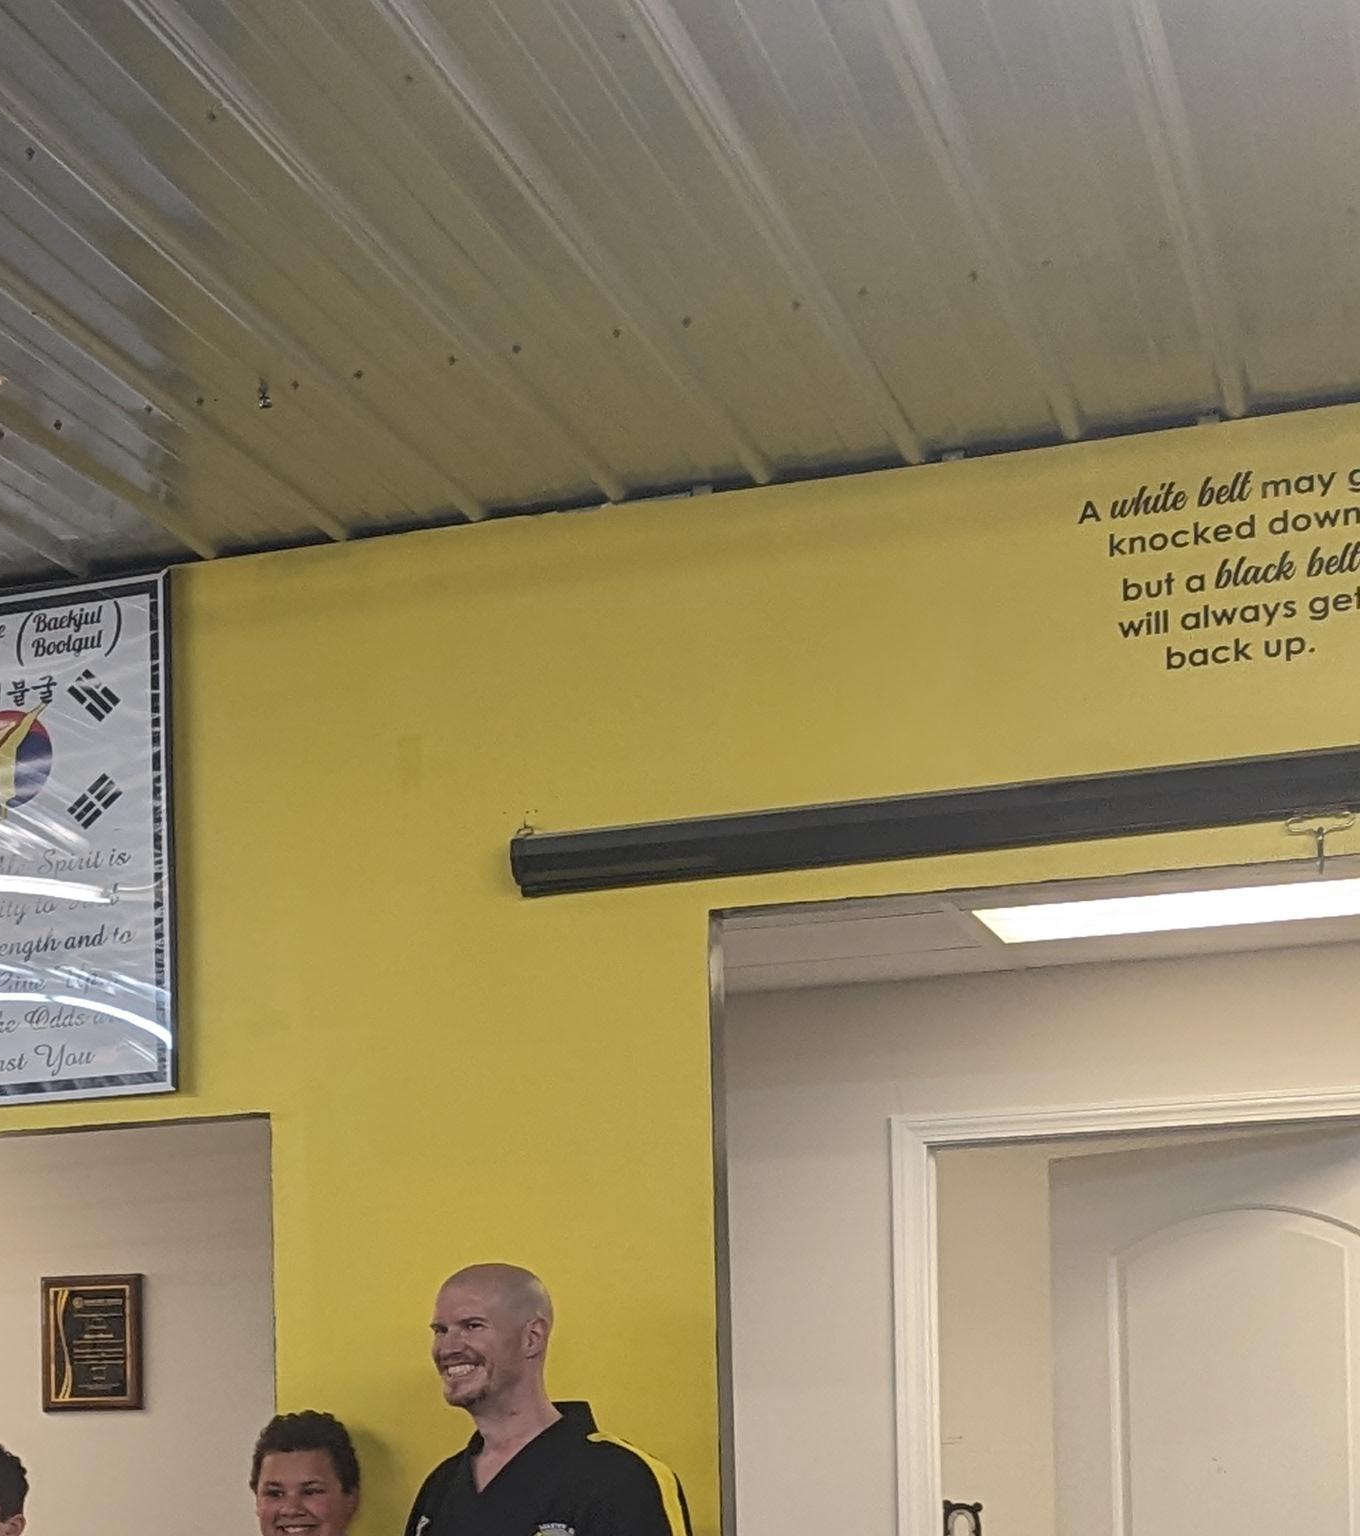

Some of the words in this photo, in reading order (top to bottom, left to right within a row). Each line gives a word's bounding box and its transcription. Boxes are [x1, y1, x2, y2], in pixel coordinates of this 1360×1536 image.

[1078, 501, 1101, 524] A
[1111, 481, 1188, 519] white
[1198, 470, 1252, 507] belt
[1261, 471, 1337, 499] may
[1110, 514, 1255, 556] knocked
[1122, 573, 1174, 600] but
[1186, 574, 1205, 592] a
[1215, 551, 1296, 588] black
[1307, 542, 1360, 577] belt
[1119, 610, 1168, 638] will
[1181, 600, 1296, 630] always
[1167, 639, 1252, 669] back
[1264, 636, 1315, 661] up.
[38, 850, 104, 879] Spirit
[110, 850, 131, 866] is
[65, 925, 107, 950] and
[113, 929, 133, 945] to
[25, 1007, 85, 1029] Odds
[34, 1044, 95, 1076] You
